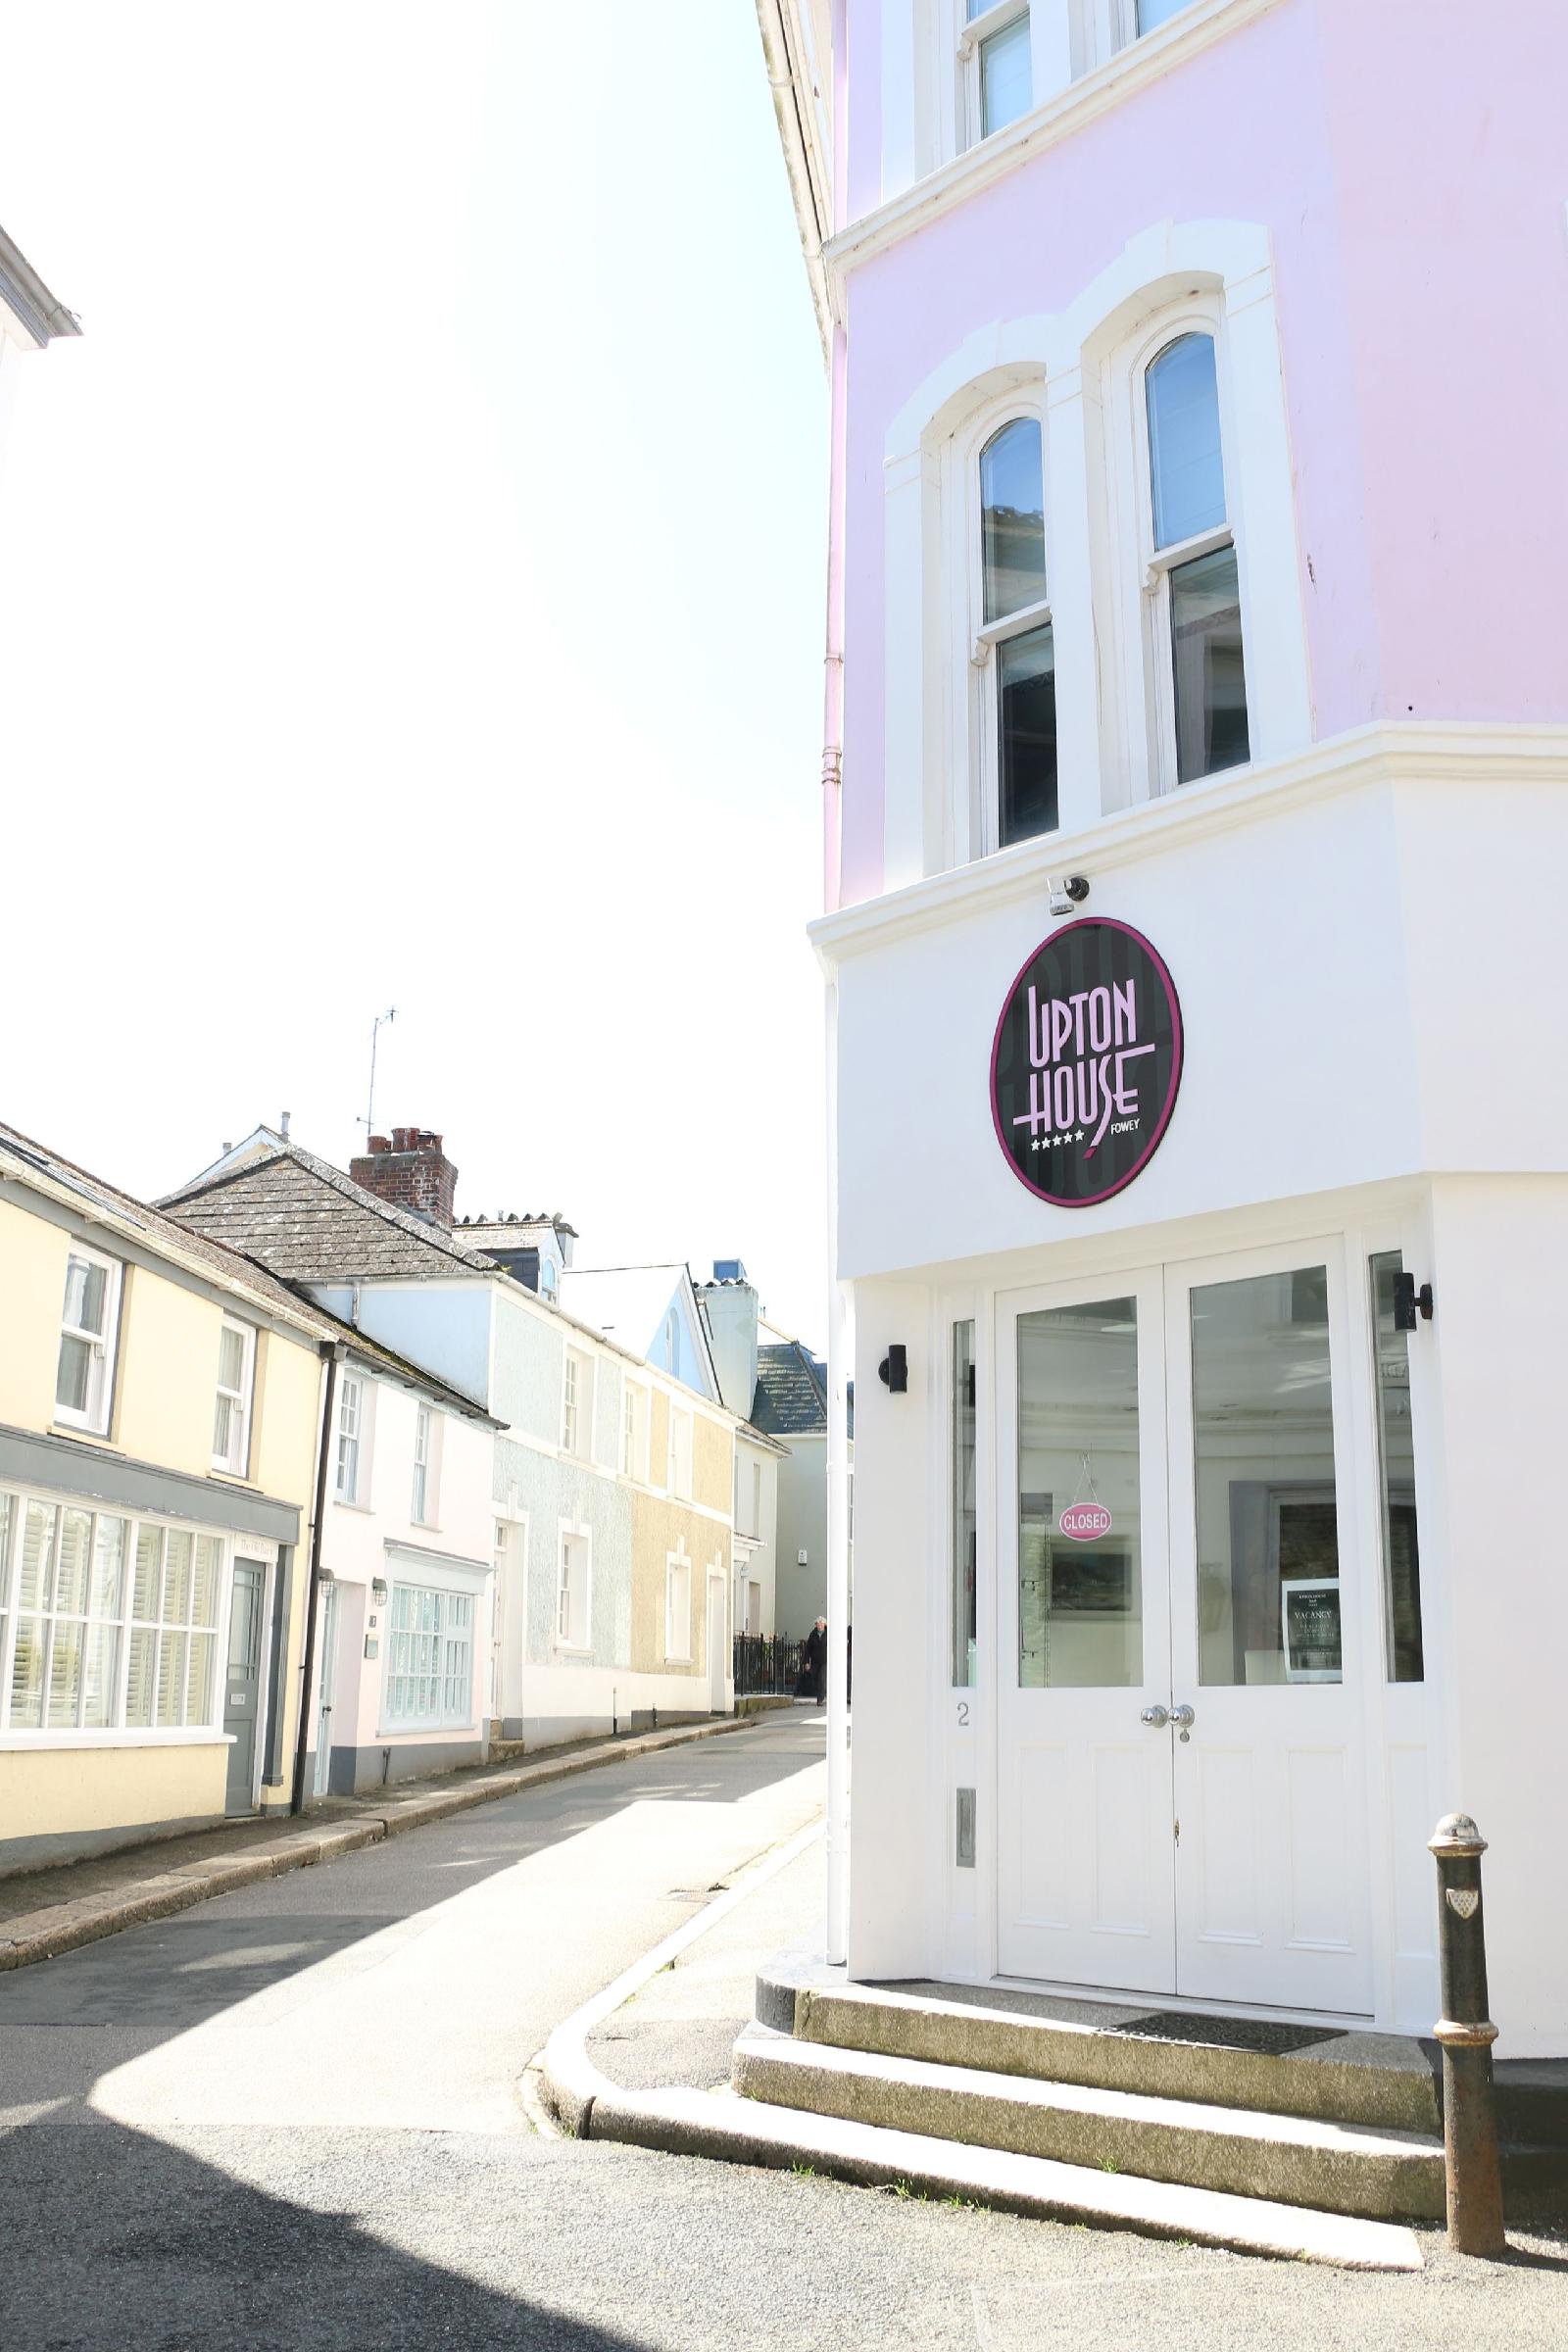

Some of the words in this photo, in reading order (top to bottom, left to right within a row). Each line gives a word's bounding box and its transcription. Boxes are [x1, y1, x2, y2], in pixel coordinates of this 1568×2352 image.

[1028, 978, 1137, 1068] UPTON
[1012, 1043, 1155, 1148] HOUSE
[1110, 1117, 1141, 1135] FOWEY
[1063, 1512, 1108, 1531] CLOSED
[1295, 1610, 1332, 1619] VACANCY
[956, 1701, 969, 1727] 2
